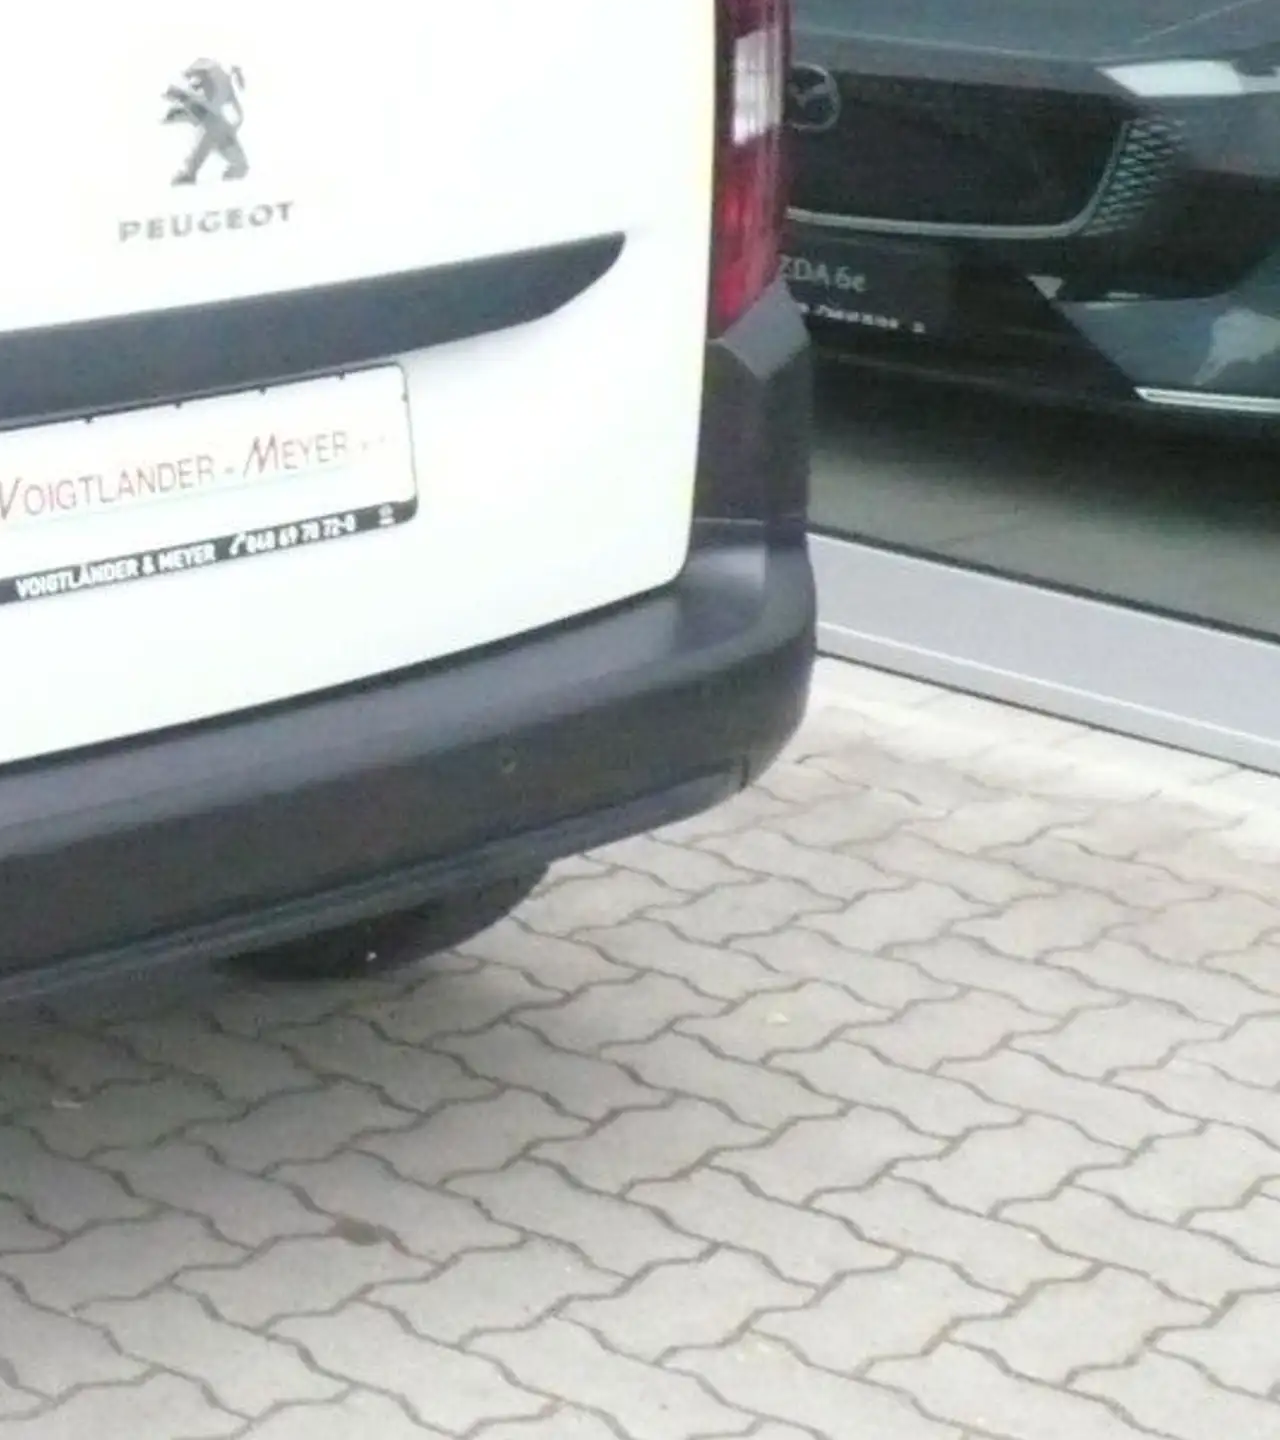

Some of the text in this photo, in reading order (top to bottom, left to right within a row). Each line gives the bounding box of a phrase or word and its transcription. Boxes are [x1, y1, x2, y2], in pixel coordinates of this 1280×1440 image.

[118, 199, 295, 243] PEUGEOT
[242, 430, 348, 479] MEYER
[157, 543, 216, 571] MEYER
